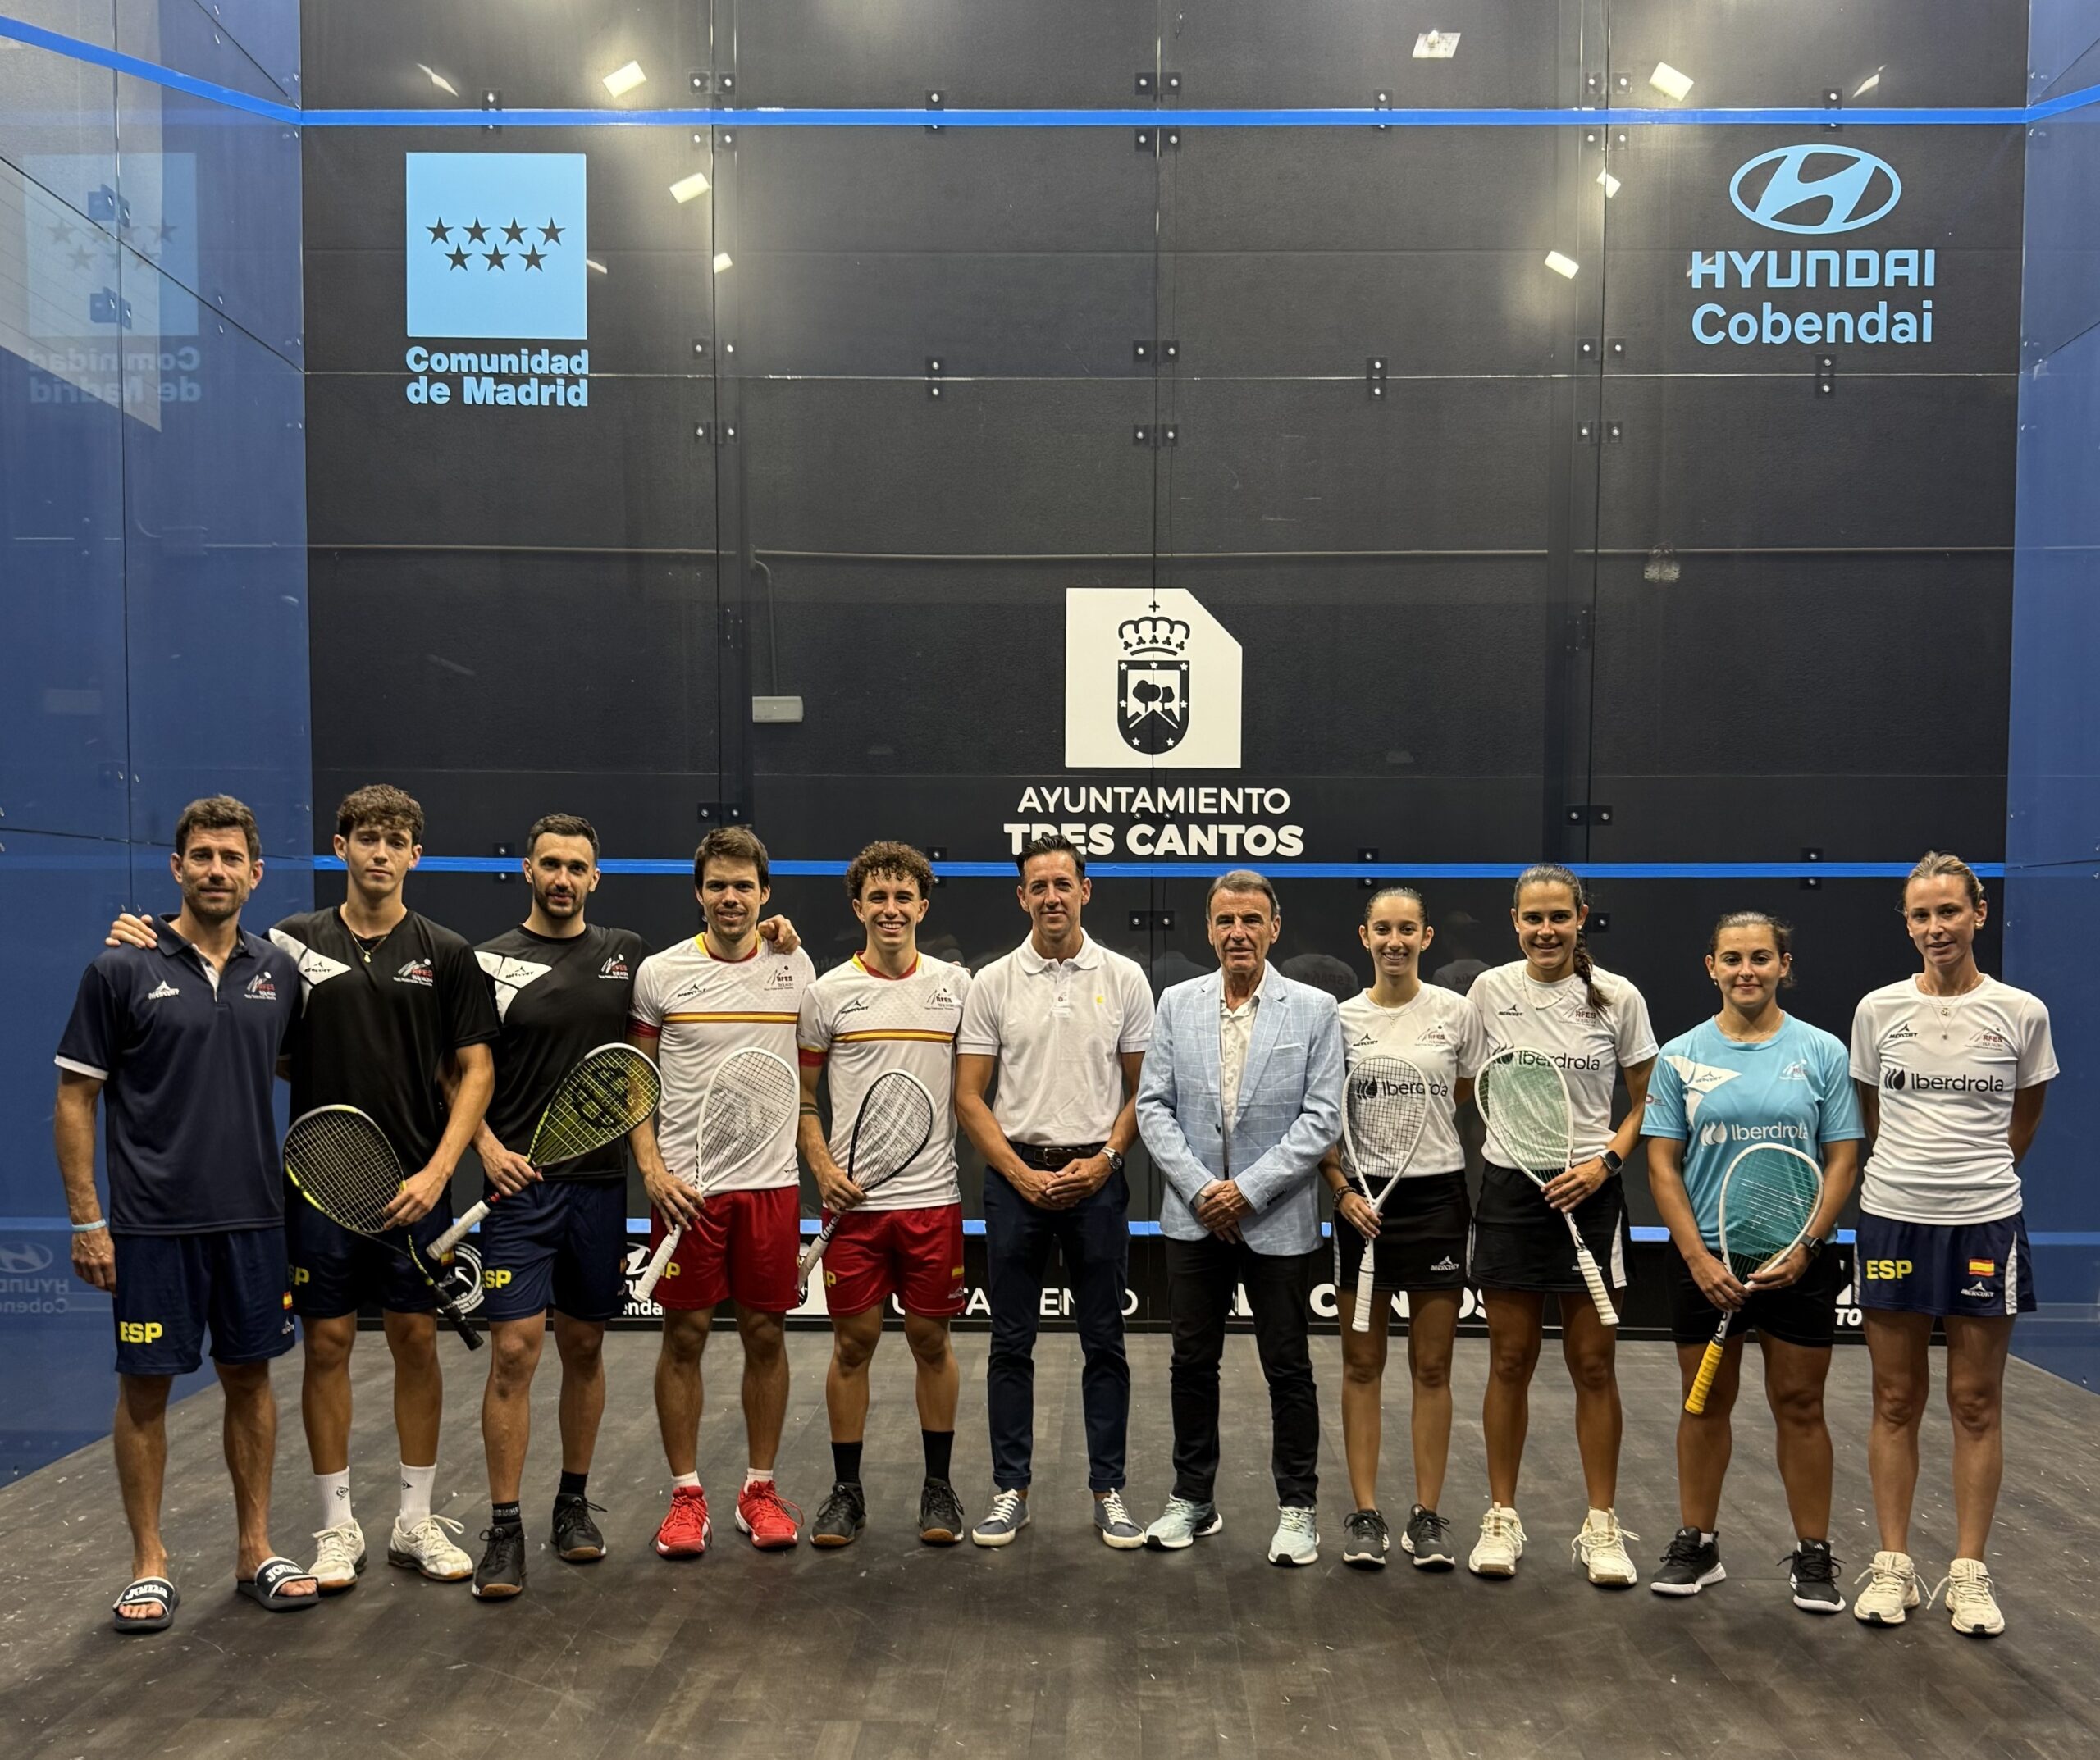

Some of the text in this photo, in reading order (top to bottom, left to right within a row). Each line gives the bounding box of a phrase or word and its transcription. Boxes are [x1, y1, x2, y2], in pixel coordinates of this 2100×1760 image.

[1691, 249, 1936, 289] HYUNDAI
[1691, 300, 1933, 345] Cobendai
[405, 346, 589, 376] Comunidad
[406, 376, 588, 407] de Madrid
[1017, 787, 1291, 814] AYUNTAMIENTO
[1125, 823, 1305, 857] CANTOS
[1911, 1072, 2004, 1092] Iberdrola
[481, 1270, 512, 1289] SP
[1865, 1259, 1913, 1280] ESP
[119, 1320, 163, 1343] ESP
